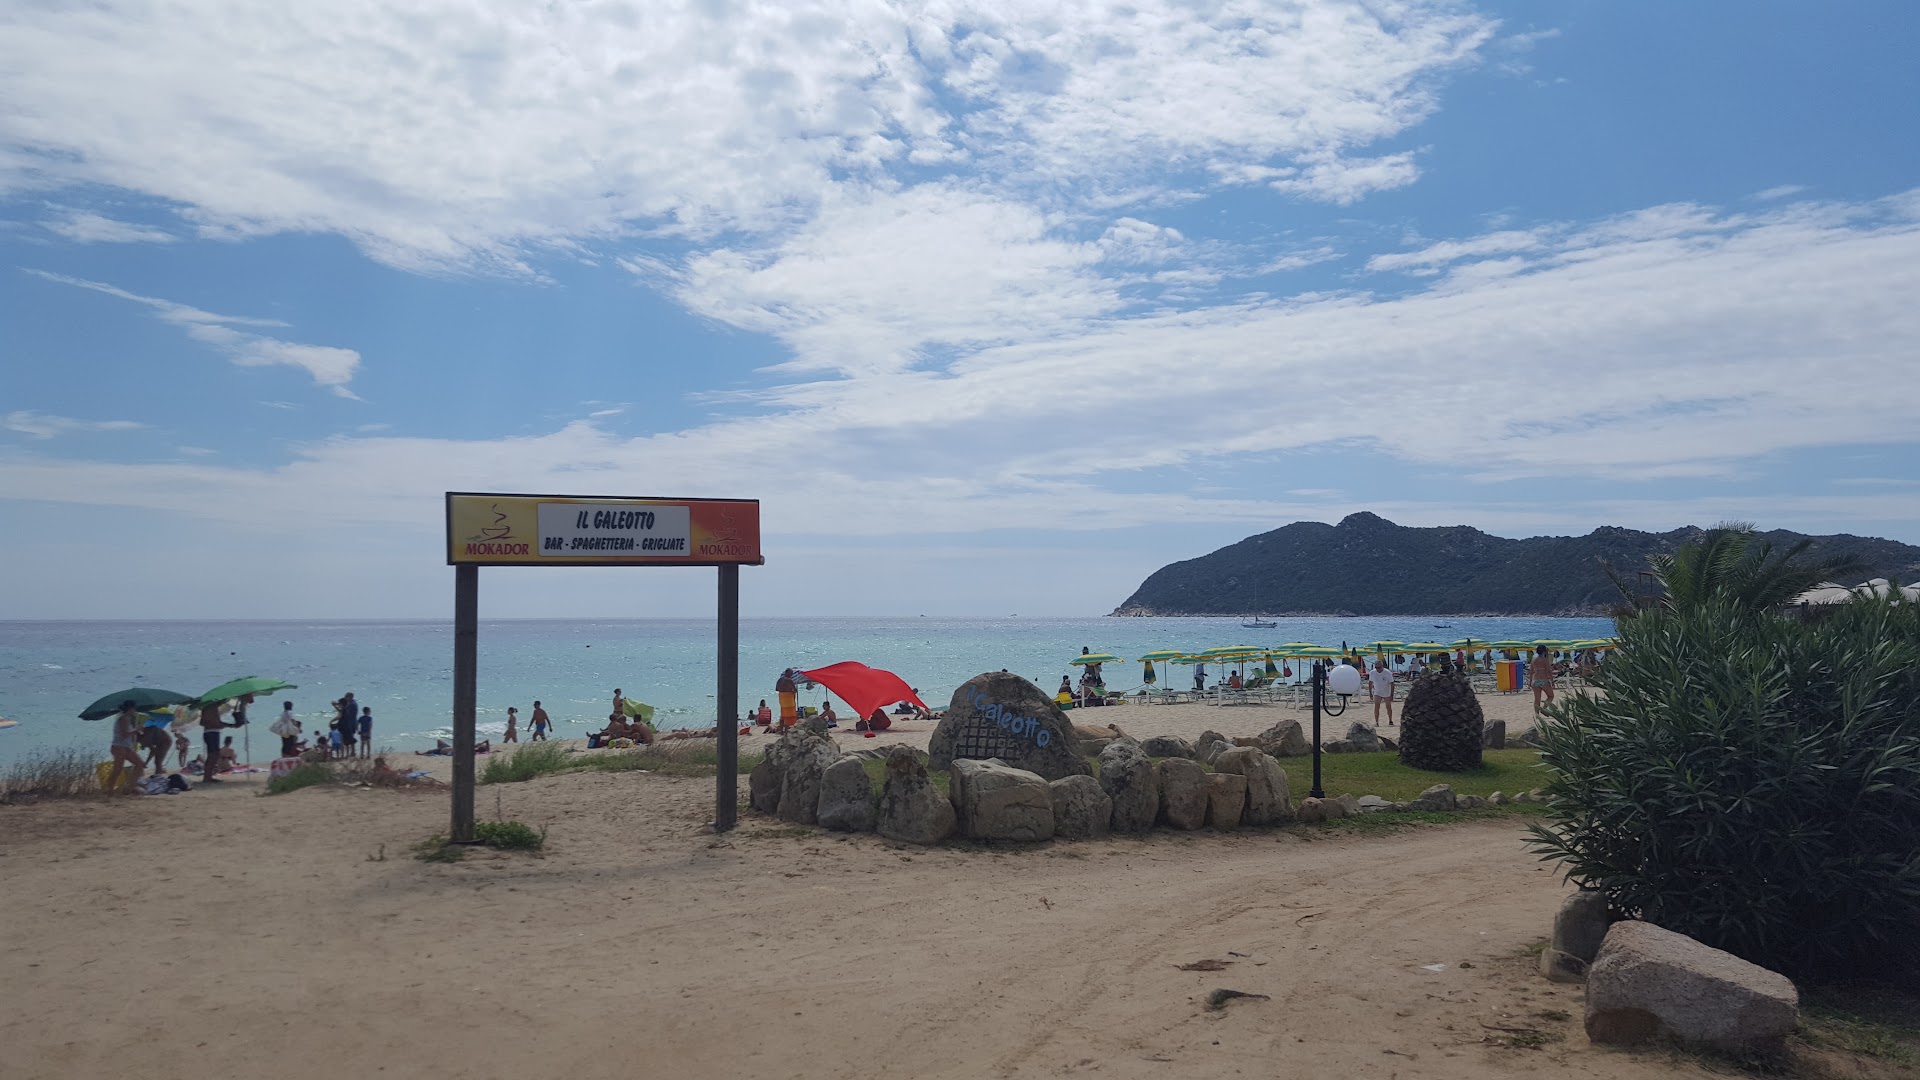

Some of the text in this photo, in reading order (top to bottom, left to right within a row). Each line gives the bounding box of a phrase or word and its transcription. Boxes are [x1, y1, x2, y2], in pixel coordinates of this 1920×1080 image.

[576, 510, 655, 530] IL GALEOTTO
[466, 543, 529, 555] MOKADOR
[544, 537, 563, 550] BAR
[571, 537, 634, 551] SPAGHETTERIA
[642, 538, 685, 551] GRIGLIATE
[699, 544, 752, 556] MOKADOR
